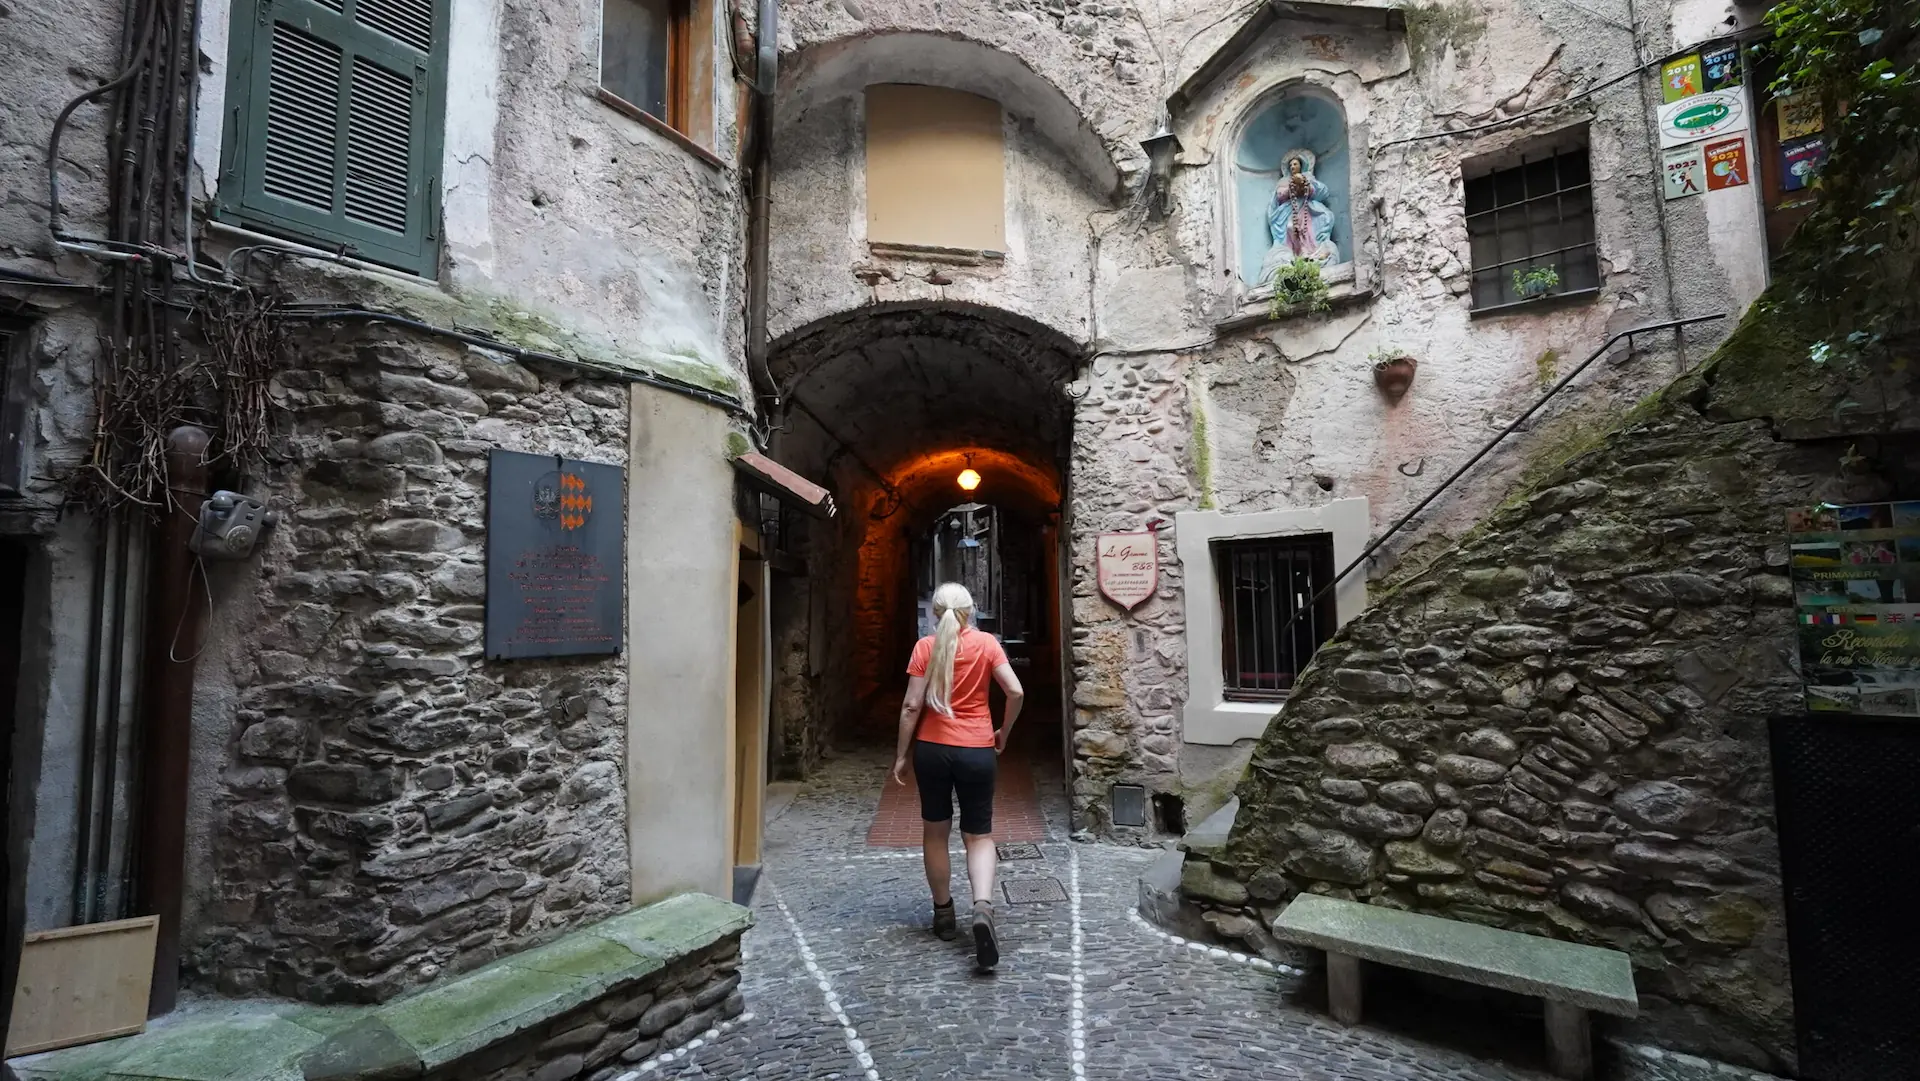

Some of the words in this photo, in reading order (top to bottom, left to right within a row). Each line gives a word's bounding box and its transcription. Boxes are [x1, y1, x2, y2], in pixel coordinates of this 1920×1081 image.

[1667, 63, 1695, 76] 2019
[1711, 150, 1739, 162] 2021
[1667, 160, 1697, 171] 2022
[1102, 545, 1116, 558] Le
[1132, 561, 1154, 571] B&B
[1813, 570, 1880, 579] PRIMAVERA
